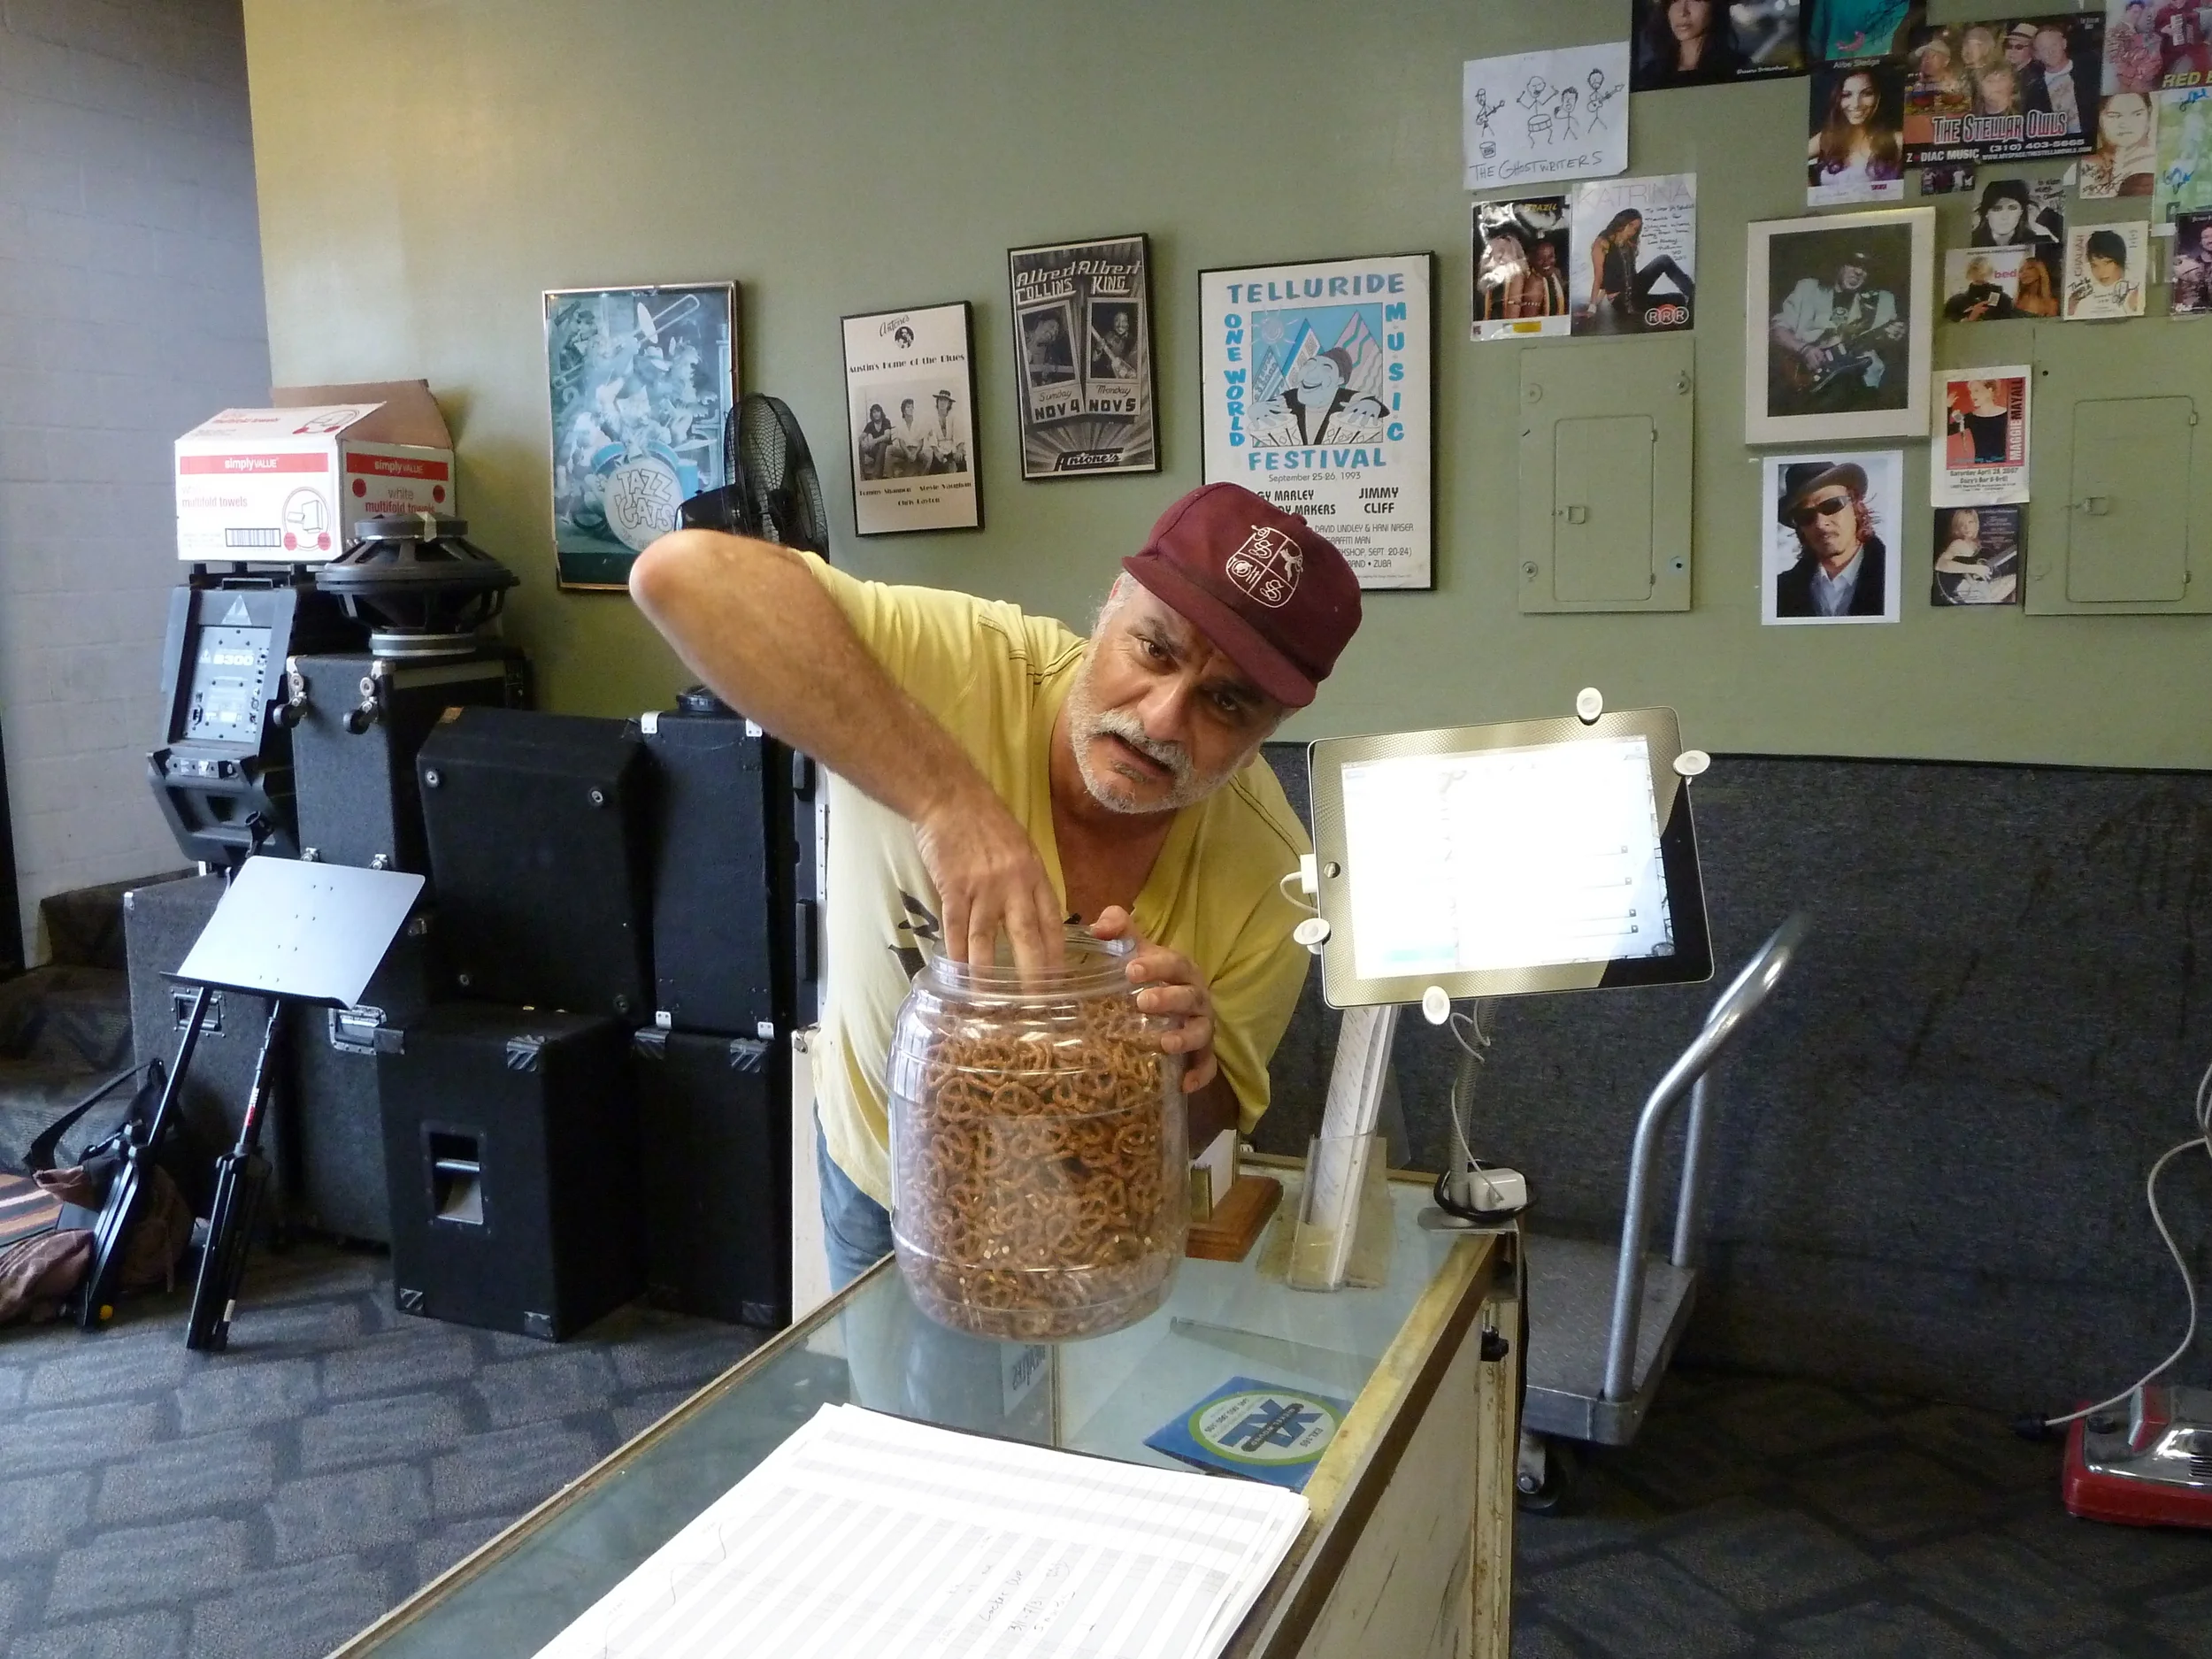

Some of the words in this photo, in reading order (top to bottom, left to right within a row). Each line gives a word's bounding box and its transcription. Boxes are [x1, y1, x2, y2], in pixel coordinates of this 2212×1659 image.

[2162, 72, 2201, 88] RED
[1932, 116, 1961, 144] THE
[1962, 113, 2024, 143] STELLAR
[1947, 149, 1979, 160] MUSIC
[1469, 163, 1495, 180] THE
[1577, 180, 1694, 209] KATRINA
[1017, 261, 1076, 287] Albert
[1078, 260, 1141, 274] Albert
[1091, 276, 1127, 295] KING
[1226, 273, 1405, 303] TELLURIDE
[1224, 314, 1243, 362] ONE
[1089, 399, 1122, 412] NOV
[1125, 398, 1136, 411] 5
[2010, 379, 2024, 419] MAYALL
[1034, 403, 1066, 420] NOV
[1071, 399, 1080, 412] 4
[1224, 368, 1247, 447] WORLD
[2009, 419, 2023, 460] MAGGIE
[1248, 447, 1387, 471] FESTIVAL
[1269, 473, 1310, 483] September
[219, 495, 248, 507] towels
[388, 488, 414, 500] white
[1274, 489, 1314, 501] MARLEY
[1359, 487, 1399, 499] JIMMY
[365, 500, 404, 513] multifold
[1294, 504, 1336, 515] MAKERS
[1363, 503, 1394, 513] CLIFF
[1355, 535, 1371, 544] MAN
